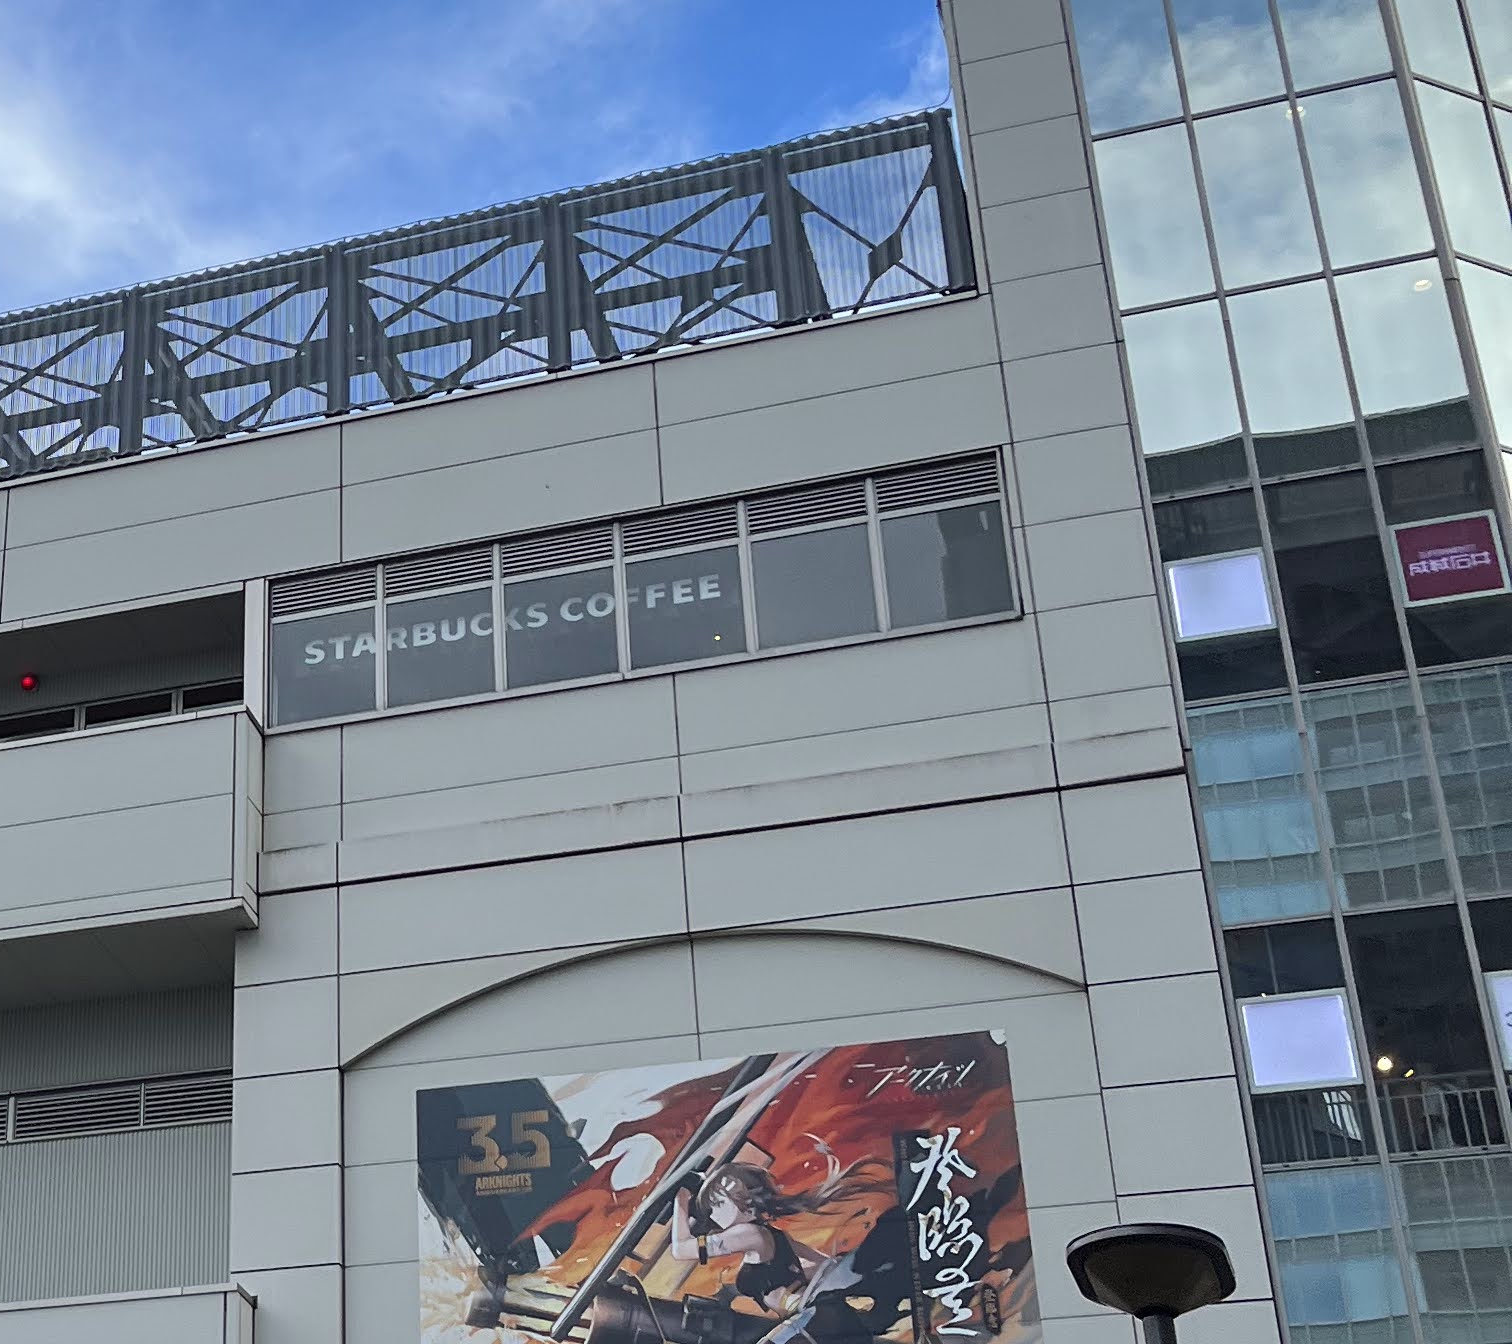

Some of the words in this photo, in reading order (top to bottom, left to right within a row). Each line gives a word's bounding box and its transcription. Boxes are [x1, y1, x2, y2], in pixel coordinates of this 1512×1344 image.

[304, 603, 548, 666] STARBUCKS
[559, 574, 722, 623] COFFEE
[456, 1109, 551, 1175] 3.5
[476, 1173, 532, 1191] ARKNIGHTS
